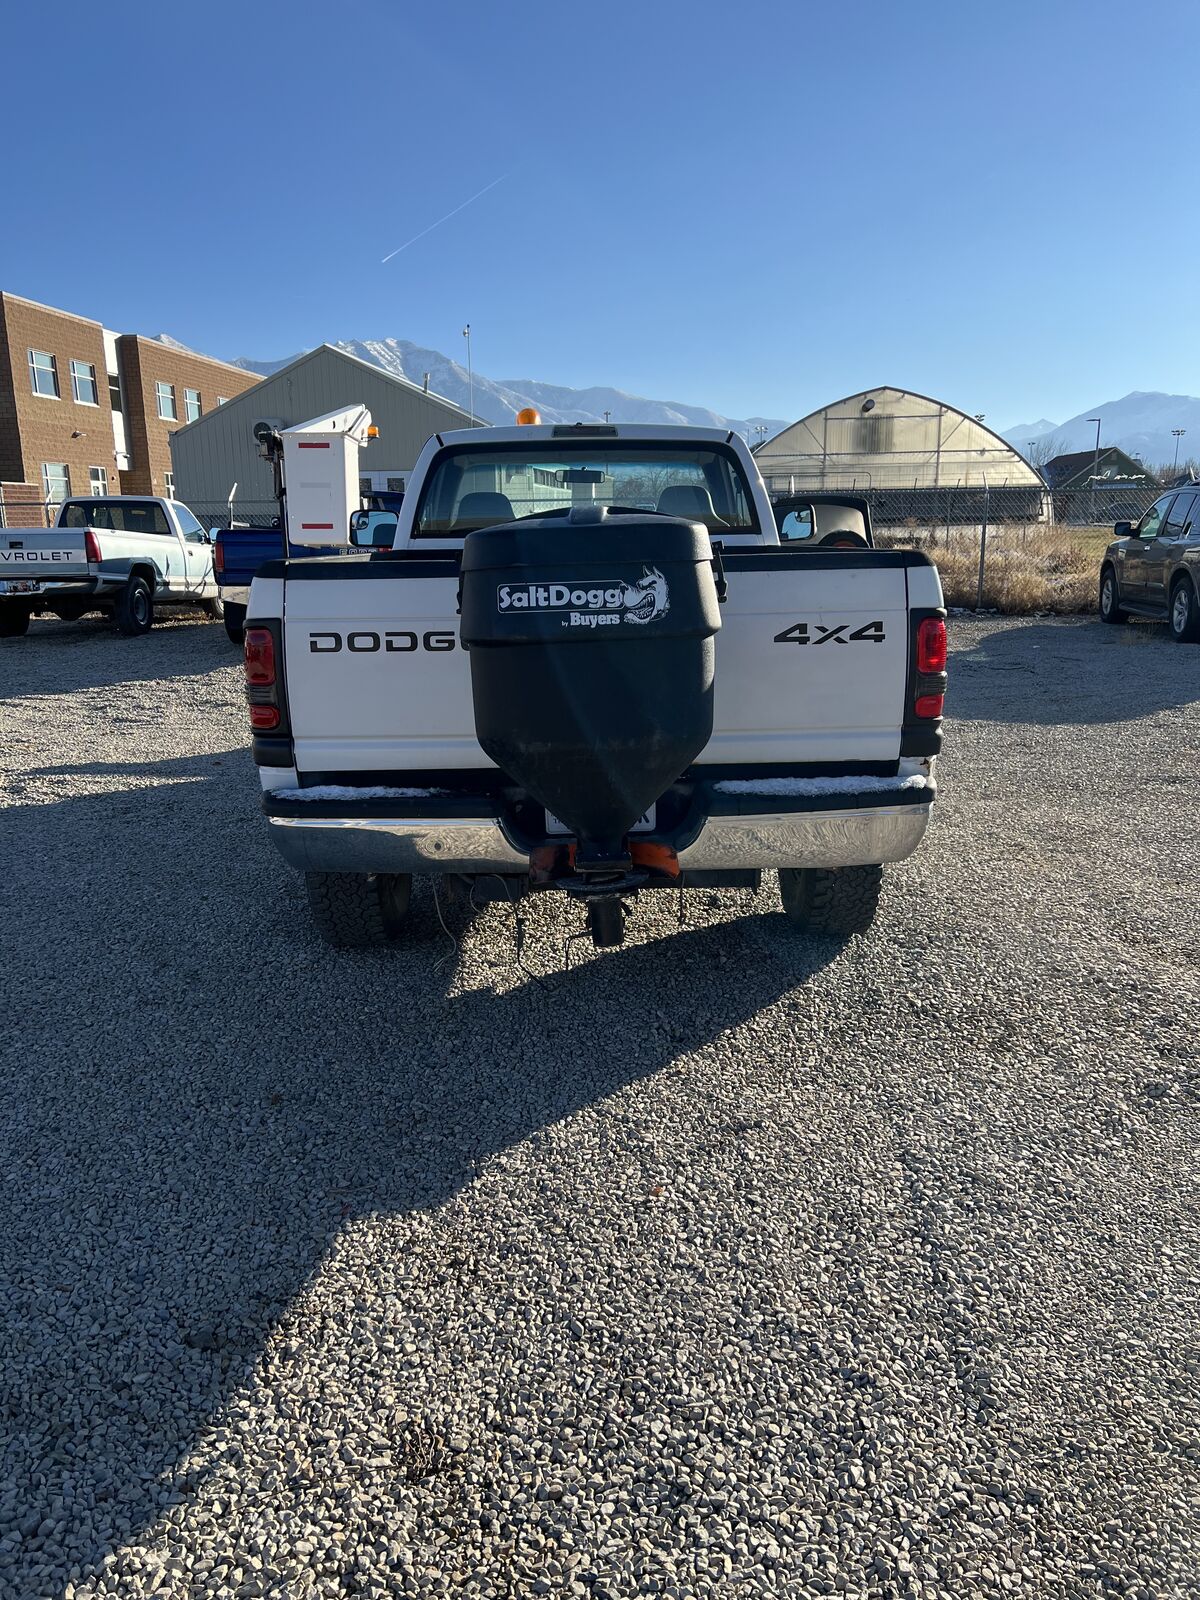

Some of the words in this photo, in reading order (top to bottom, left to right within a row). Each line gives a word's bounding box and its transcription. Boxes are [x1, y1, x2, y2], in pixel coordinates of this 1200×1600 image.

[0, 551, 73, 561] VROLET
[499, 585, 624, 609] SaltDogg
[561, 620, 569, 628] by
[570, 612, 621, 629] Buyers
[309, 631, 470, 652] DODG
